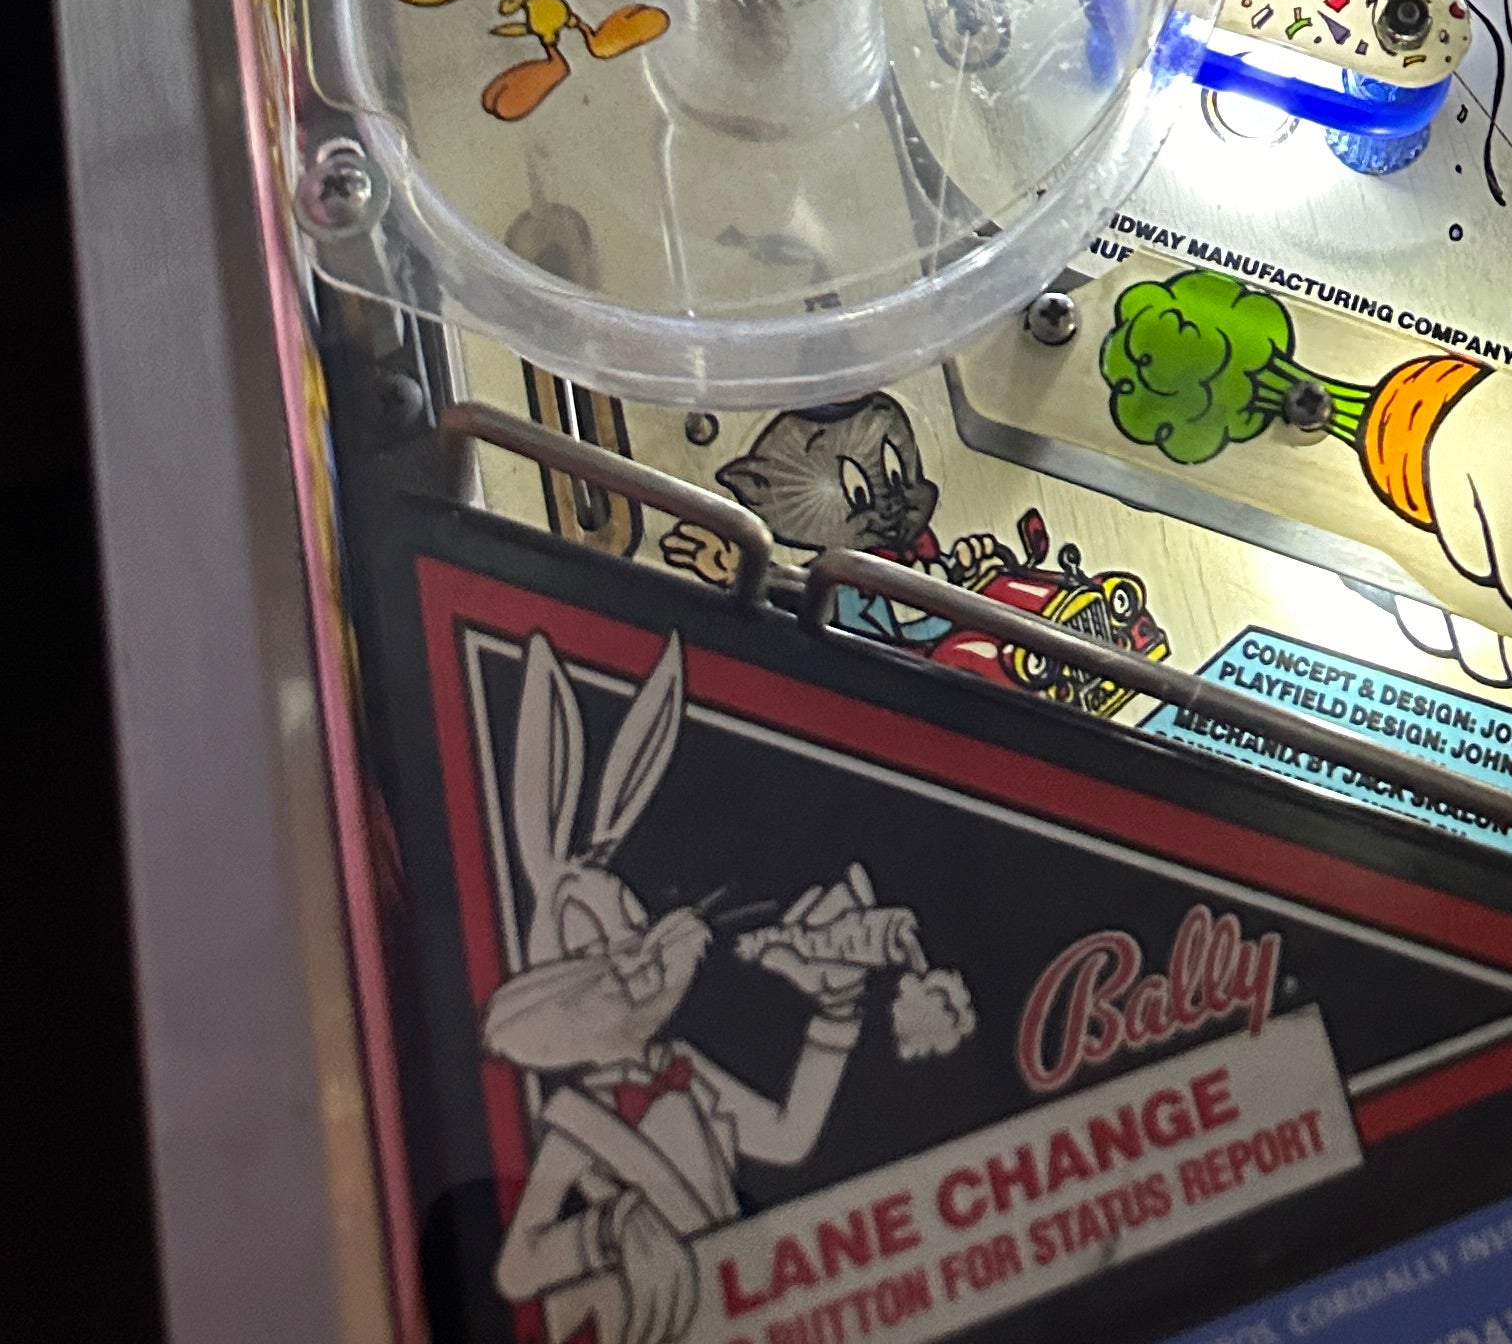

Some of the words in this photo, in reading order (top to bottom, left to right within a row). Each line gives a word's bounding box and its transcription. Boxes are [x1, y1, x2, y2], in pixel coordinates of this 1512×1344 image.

[1108, 212, 1188, 251] IDWAY
[1187, 238, 1394, 324] MANUFACTURING
[1219, 661, 1348, 719] PLAYFIELD
[1352, 703, 1448, 753] DESIGN:
[1243, 639, 1357, 692] CONCEPT
[1358, 678, 1375, 700] &
[1379, 684, 1477, 734] DESIGN:
[1016, 904, 1283, 1095] Bally
[718, 1188, 922, 1319] LANE
[935, 1066, 1241, 1232] CHANGE
[939, 1232, 1021, 1302] FOR
[1028, 1174, 1173, 1267] STATUS
[1178, 1110, 1326, 1206] REPORT
